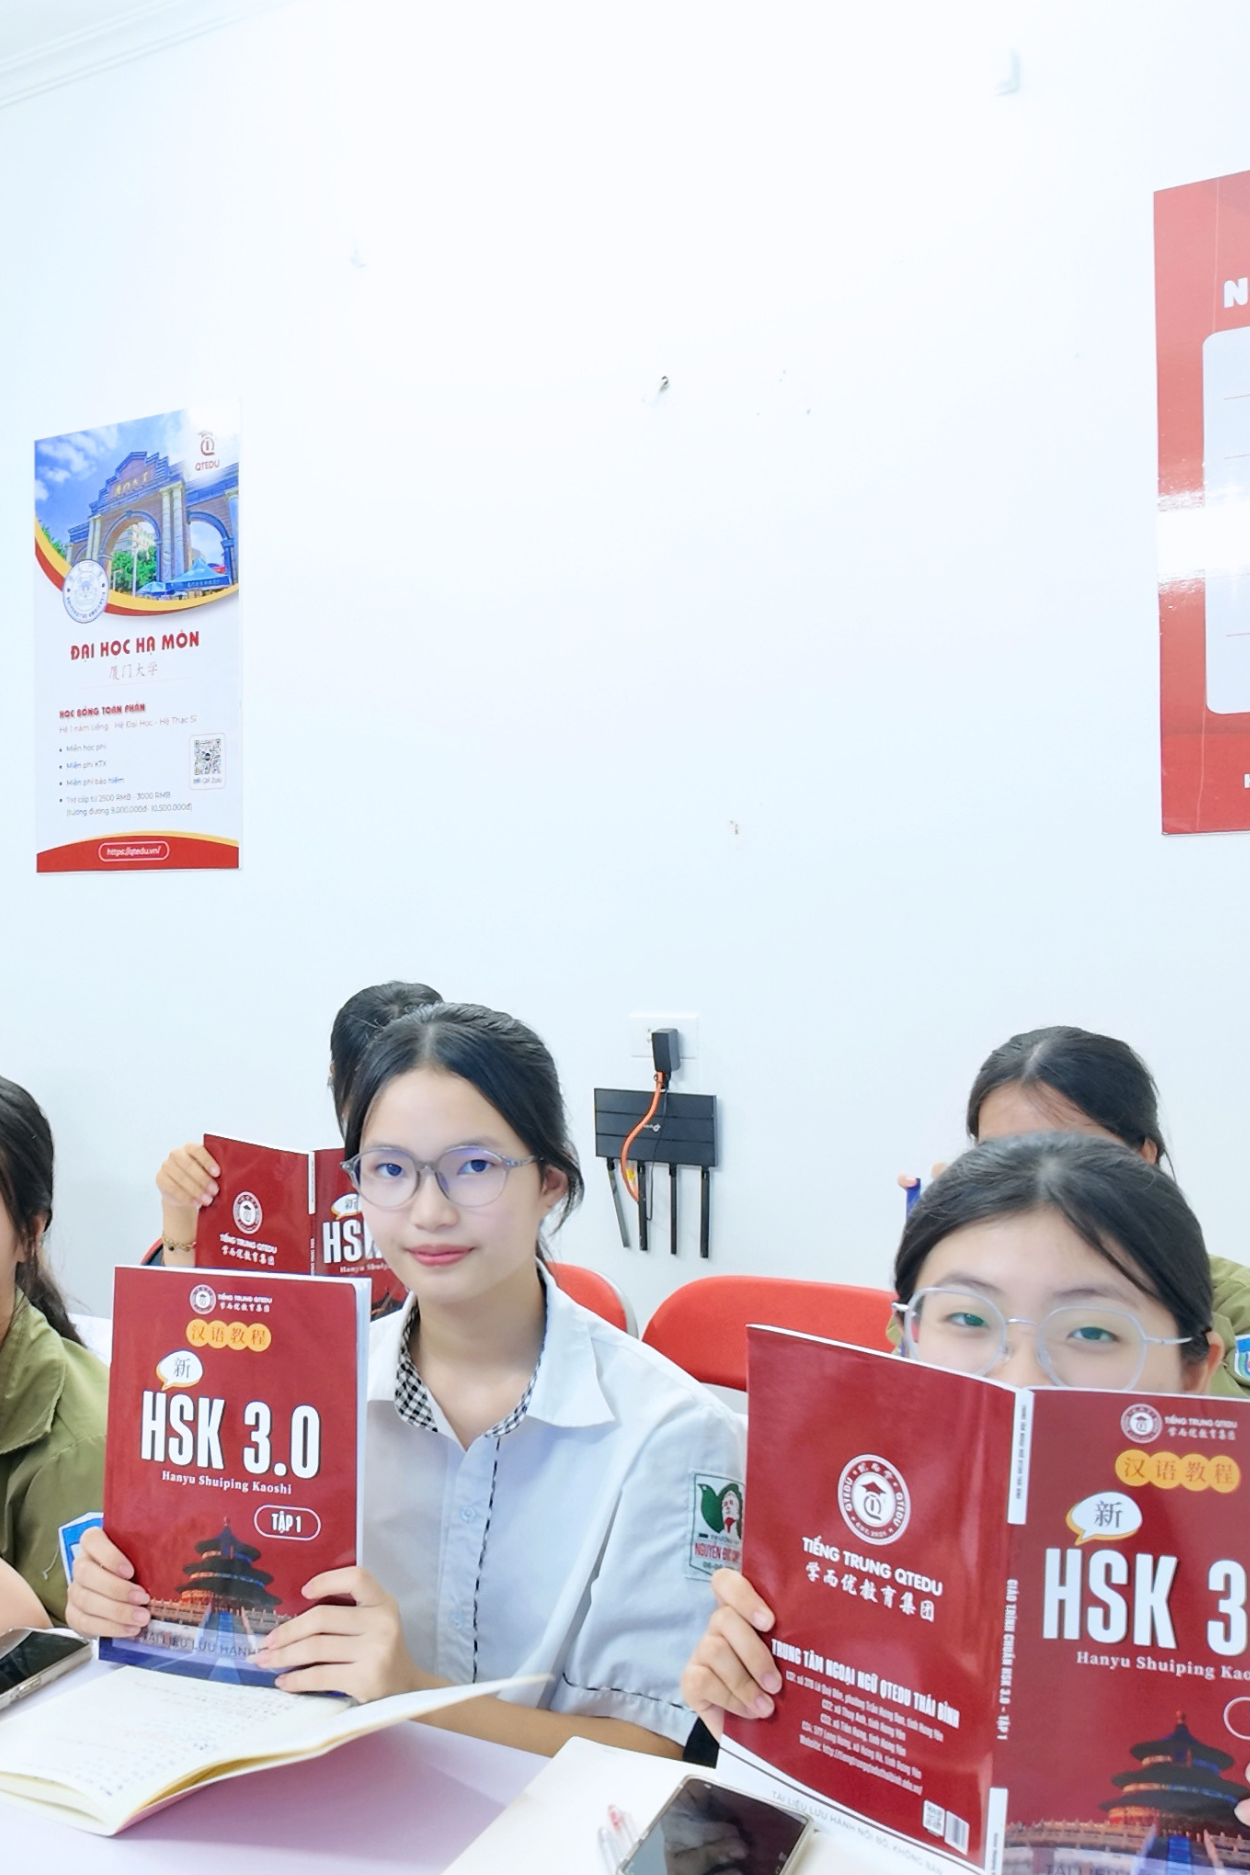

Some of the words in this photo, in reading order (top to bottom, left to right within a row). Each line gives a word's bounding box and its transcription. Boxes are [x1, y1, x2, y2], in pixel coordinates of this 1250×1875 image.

[195, 460, 220, 471] QTEDU
[70, 643, 95, 663] ĐẠI
[100, 639, 130, 660] HỌC
[161, 629, 199, 651] MÔN
[109, 661, 158, 680] 厦门大学
[191, 1324, 267, 1345] 汉语教程
[173, 1356, 191, 1379] 新
[140, 1390, 226, 1470] HSK
[243, 1401, 321, 1479] 3.0
[162, 1470, 196, 1485] Hanyu
[198, 1475, 249, 1492] Shuiping
[252, 1480, 292, 1495] Kaoshi
[1124, 1457, 1234, 1485] 汉语教程
[271, 1510, 293, 1534] TẬP
[295, 1515, 302, 1533] 1
[1094, 1500, 1124, 1529] 新
[802, 1535, 841, 1563] TIẾNG
[843, 1550, 892, 1580] TRUNG
[894, 1568, 944, 1597] QTEDU
[1005, 1579, 1019, 1602] GIÁO
[1043, 1547, 1180, 1650] HSK
[771, 1638, 802, 1665] TRUNG
[803, 1648, 824, 1674] TÂM
[825, 1658, 856, 1686] NGOẠI
[857, 1670, 879, 1694] NGỮ
[880, 1679, 911, 1707] QTEDU
[913, 1691, 937, 1718] THÁI
[1000, 1667, 1013, 1686] HSK
[1076, 1651, 1131, 1670] Hanyu
[1135, 1655, 1217, 1681] Shuiping
